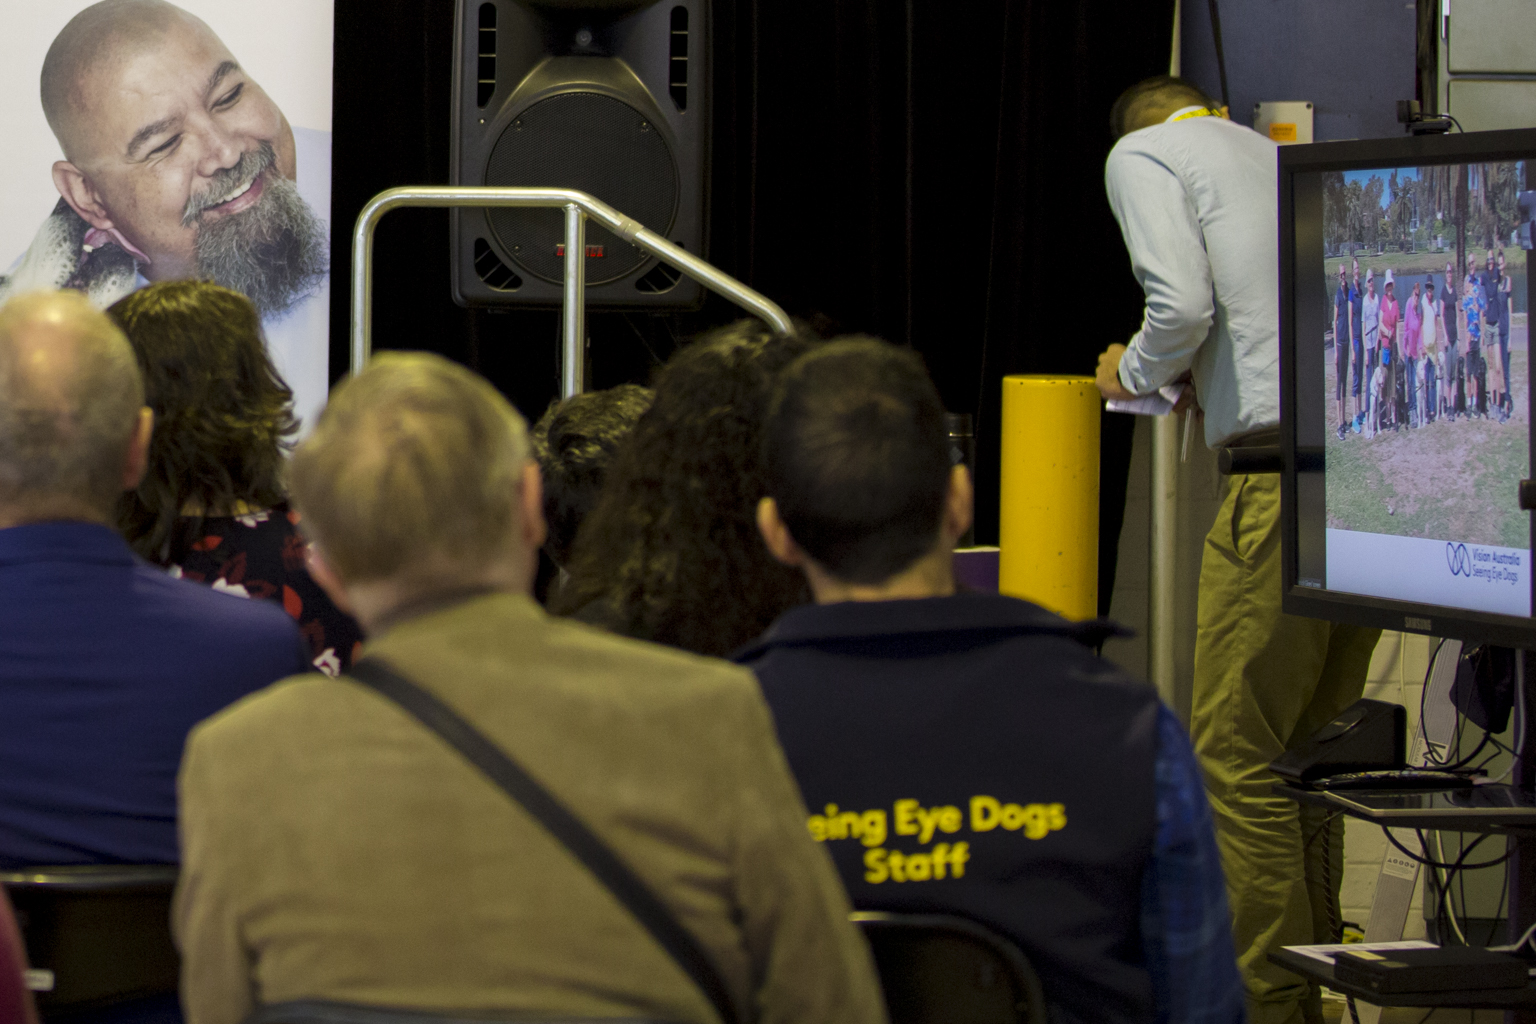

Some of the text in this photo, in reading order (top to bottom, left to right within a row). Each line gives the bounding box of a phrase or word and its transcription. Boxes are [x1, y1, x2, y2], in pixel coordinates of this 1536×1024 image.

[1473, 548, 1520, 566] Vision Australia
[1473, 564, 1518, 585] Seeing Eye Dogs
[893, 798, 962, 844] Eye
[969, 795, 1067, 840] Dogs
[864, 841, 970, 884] Staff
